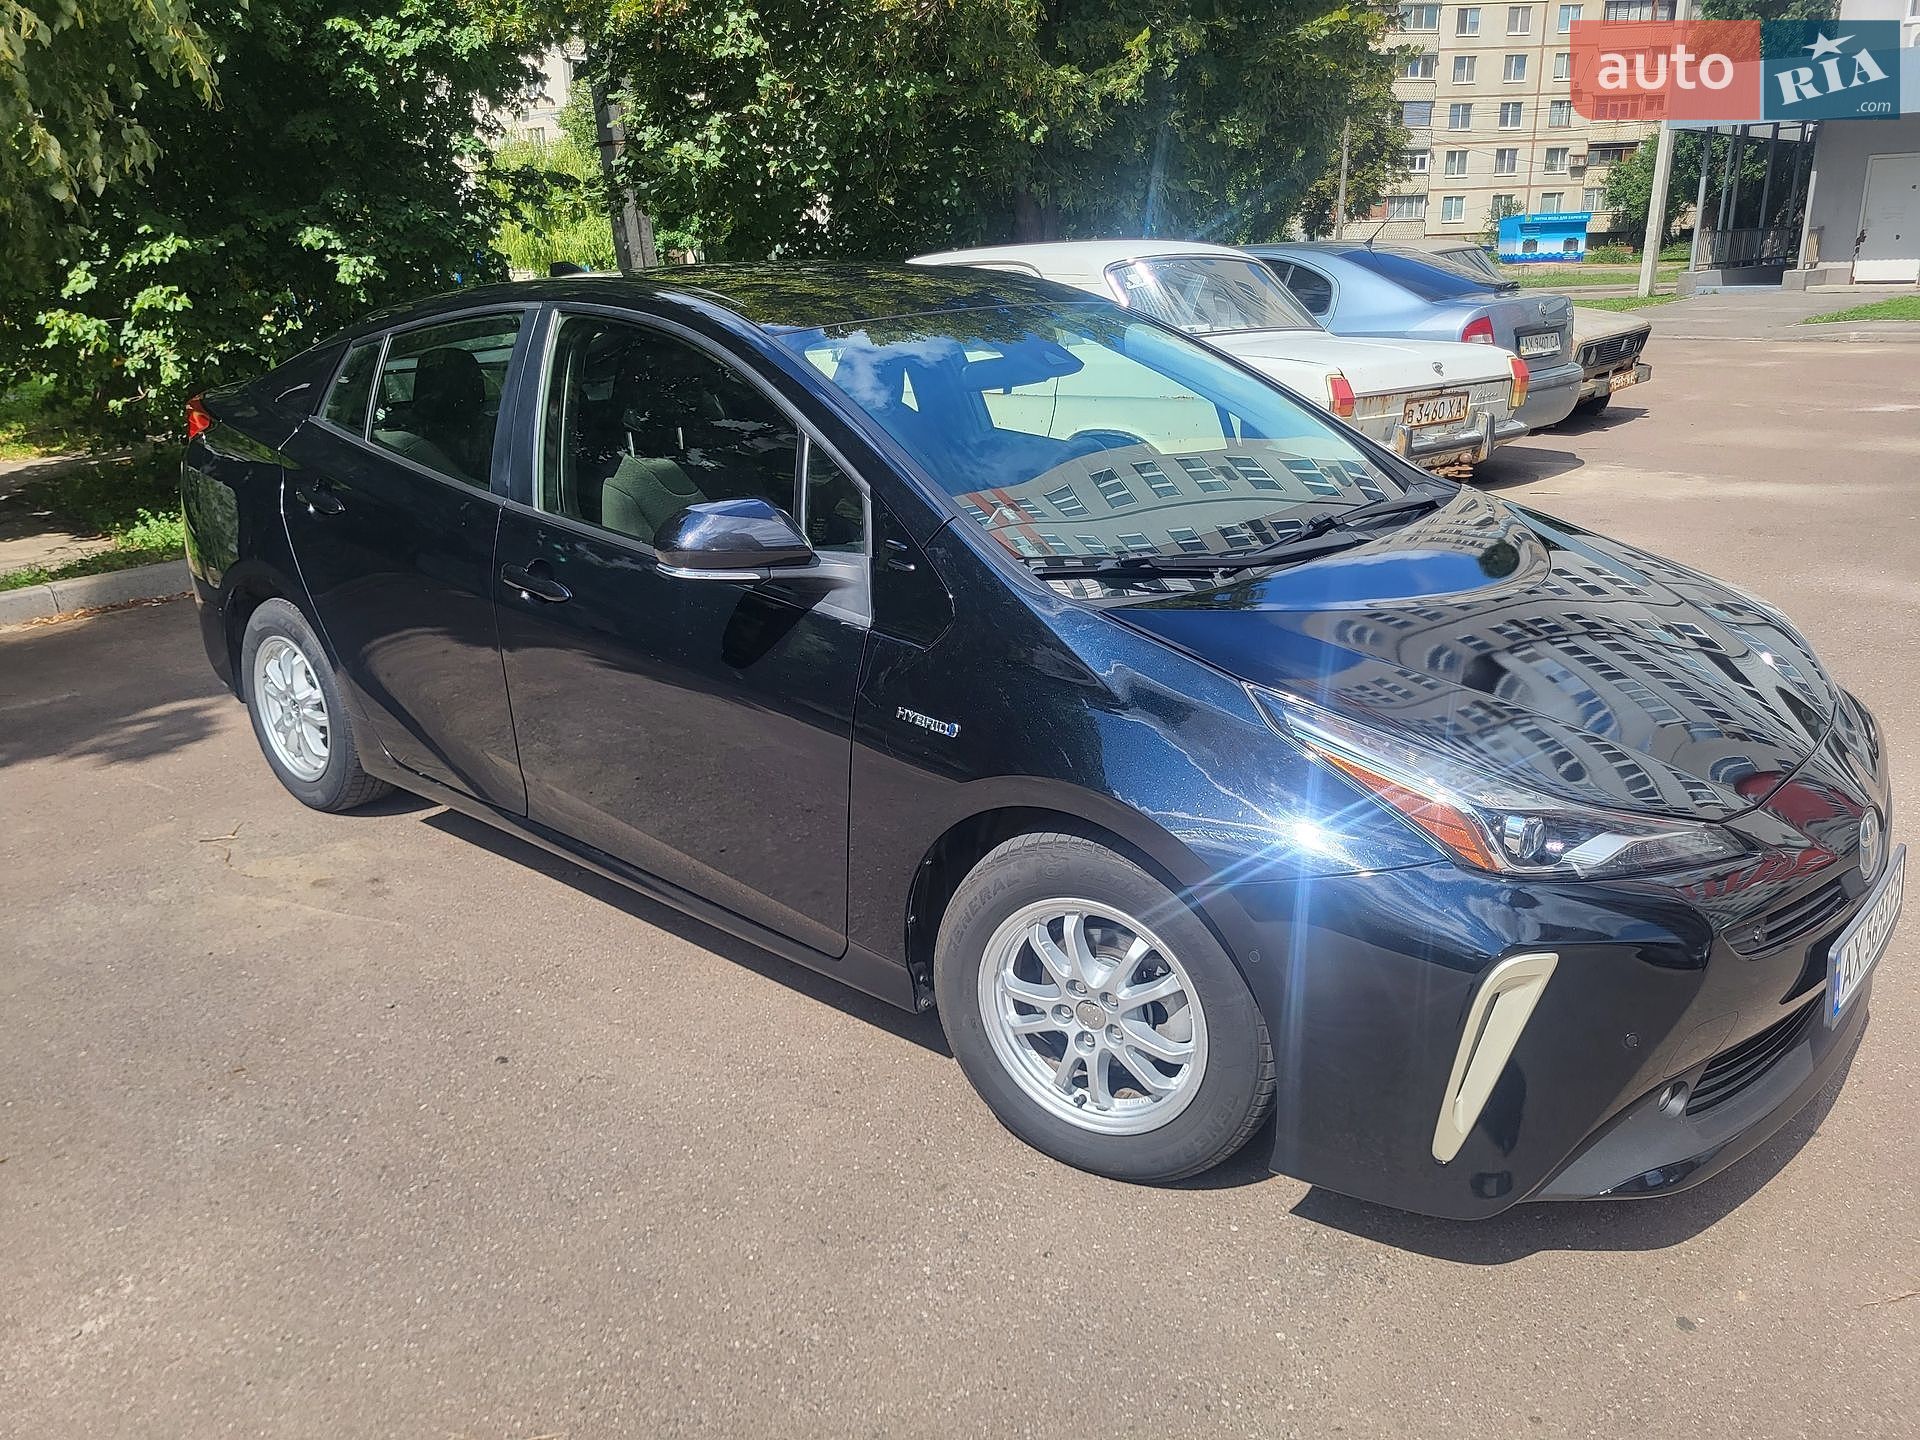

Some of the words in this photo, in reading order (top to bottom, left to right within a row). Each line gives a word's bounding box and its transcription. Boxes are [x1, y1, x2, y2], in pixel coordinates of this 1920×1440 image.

[1416, 401, 1445, 423] 3460
[895, 706, 949, 736] HYBRID
[1841, 933, 1865, 995] AX
